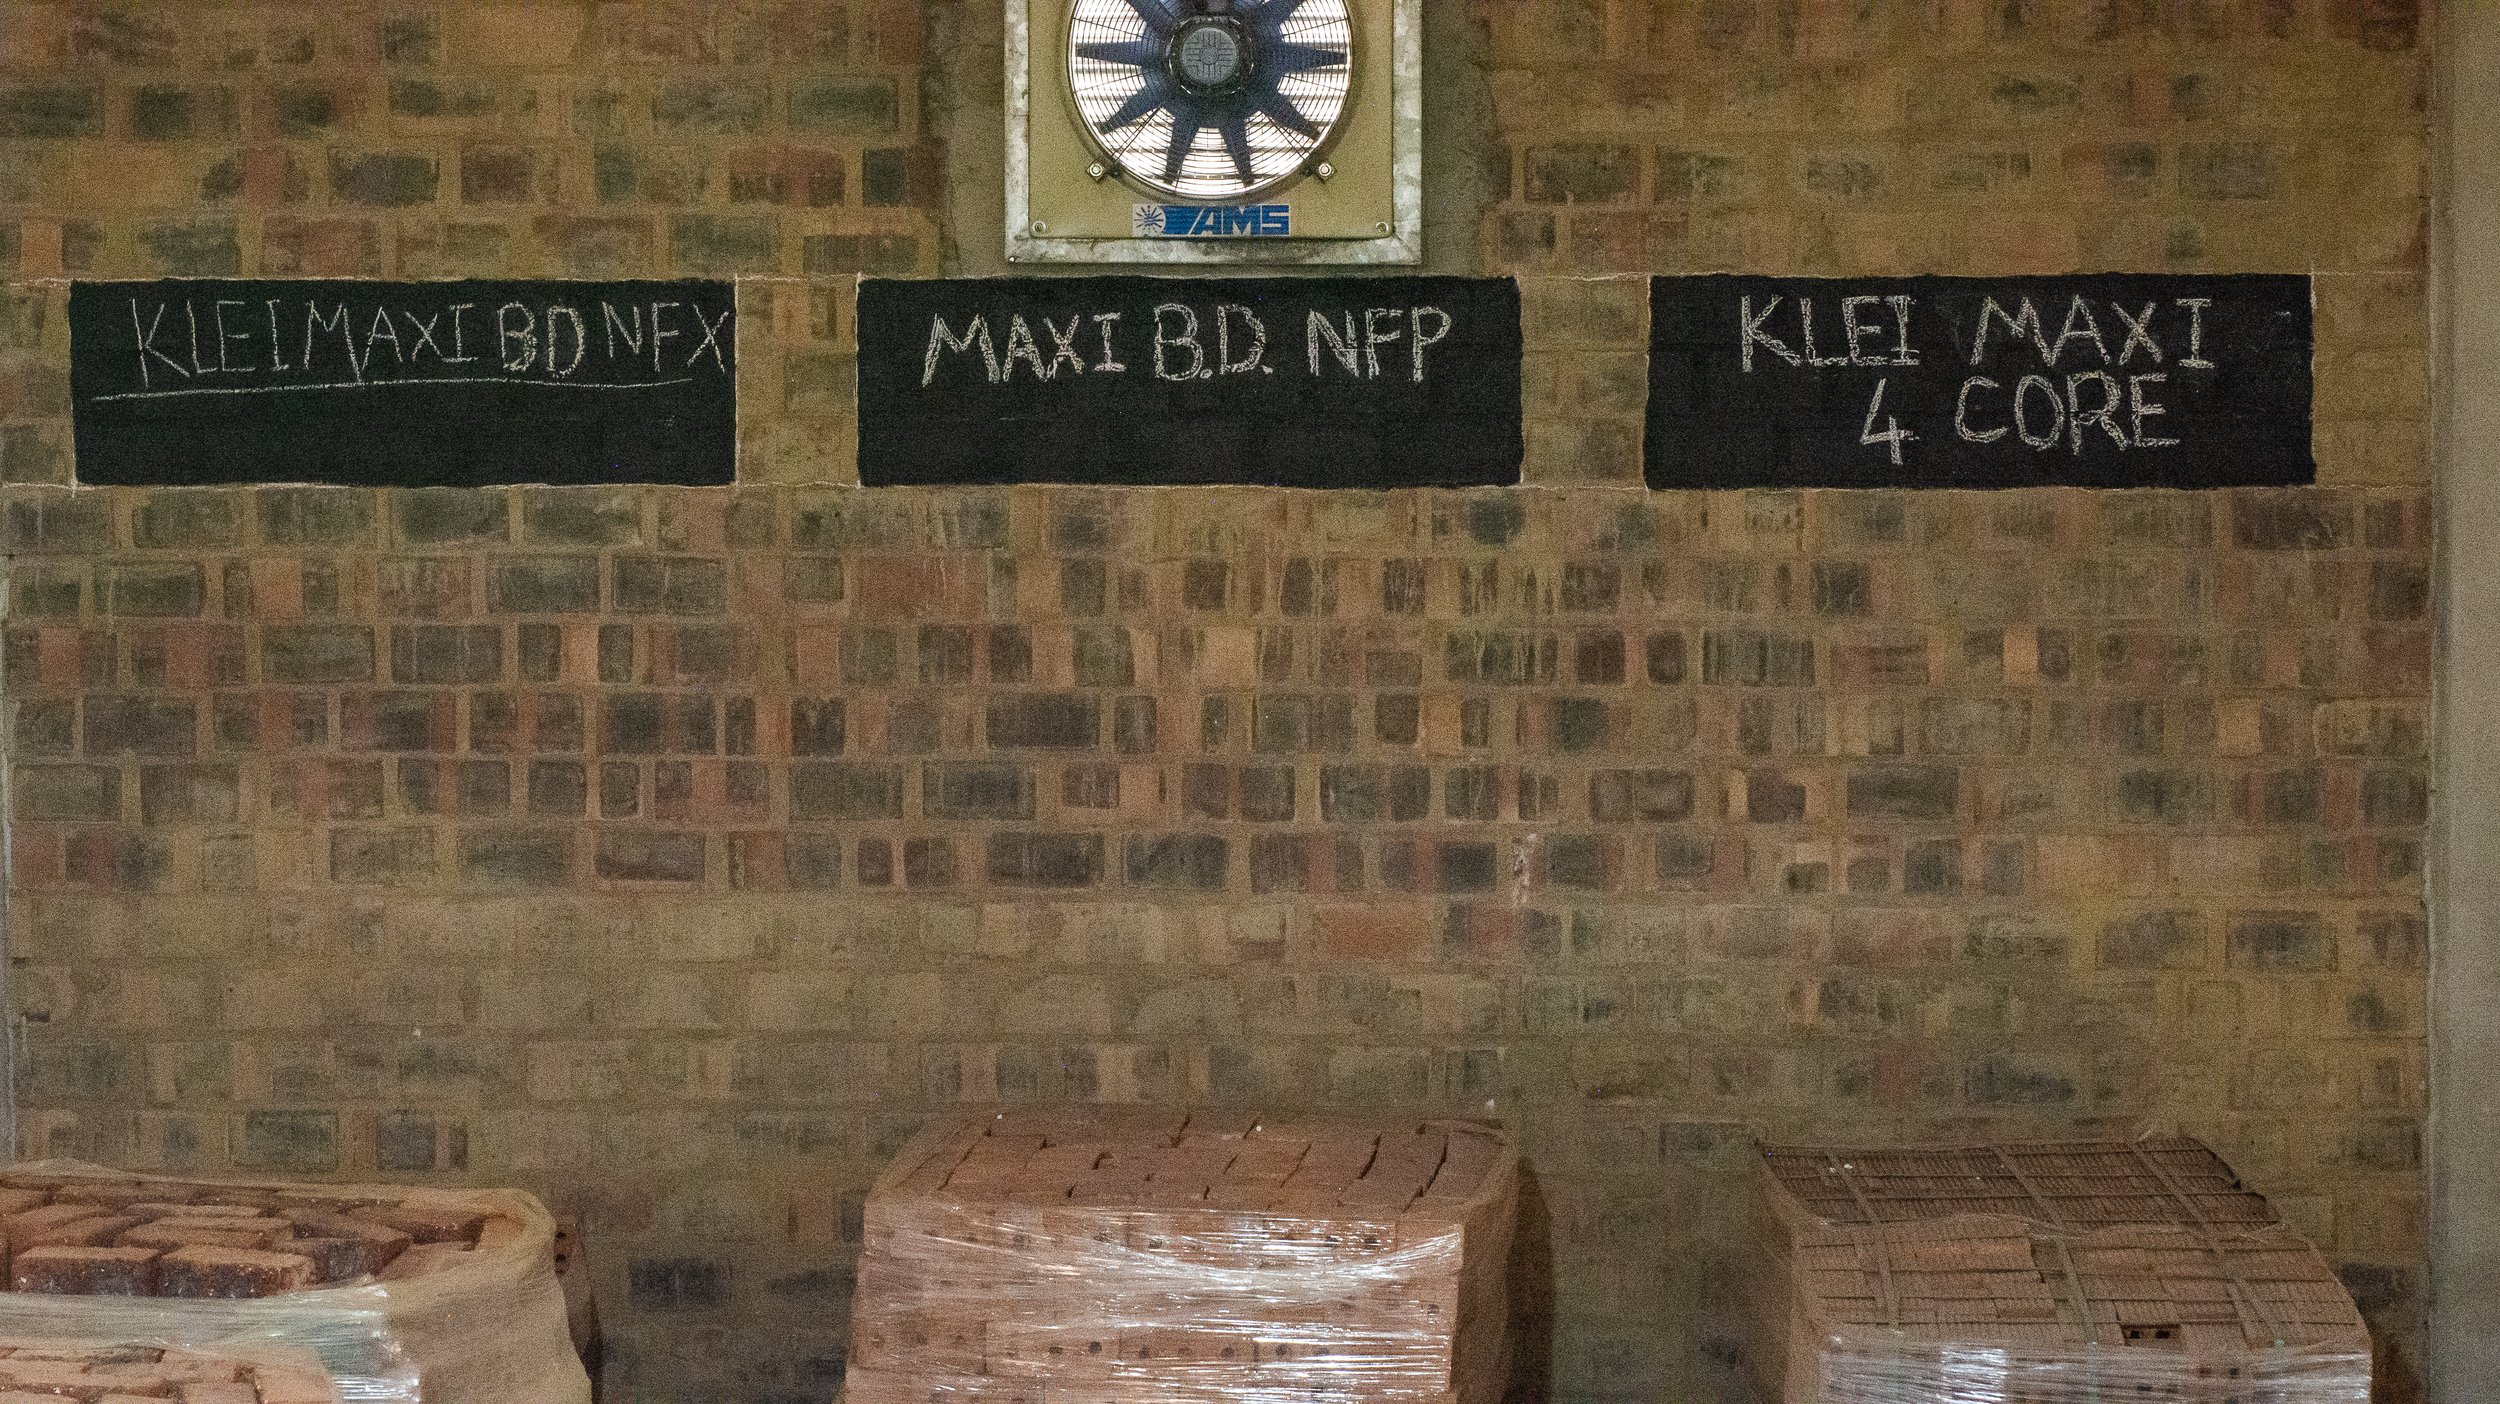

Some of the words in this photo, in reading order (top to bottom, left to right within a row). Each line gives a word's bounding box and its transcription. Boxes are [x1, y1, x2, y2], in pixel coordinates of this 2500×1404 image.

[1190, 205, 1289, 235] AMS
[132, 298, 290, 388] KLEI
[303, 299, 480, 383] MAXI
[496, 301, 586, 378] BD
[602, 301, 730, 375] NFX
[922, 311, 1125, 387] MAXI
[1154, 303, 1274, 382] B.D.
[1307, 306, 1451, 382] NFP
[1740, 294, 1920, 373] KLEI
[1970, 293, 2215, 368] MAXI
[1859, 378, 1920, 465] 4
[1953, 371, 2180, 456] CORE
